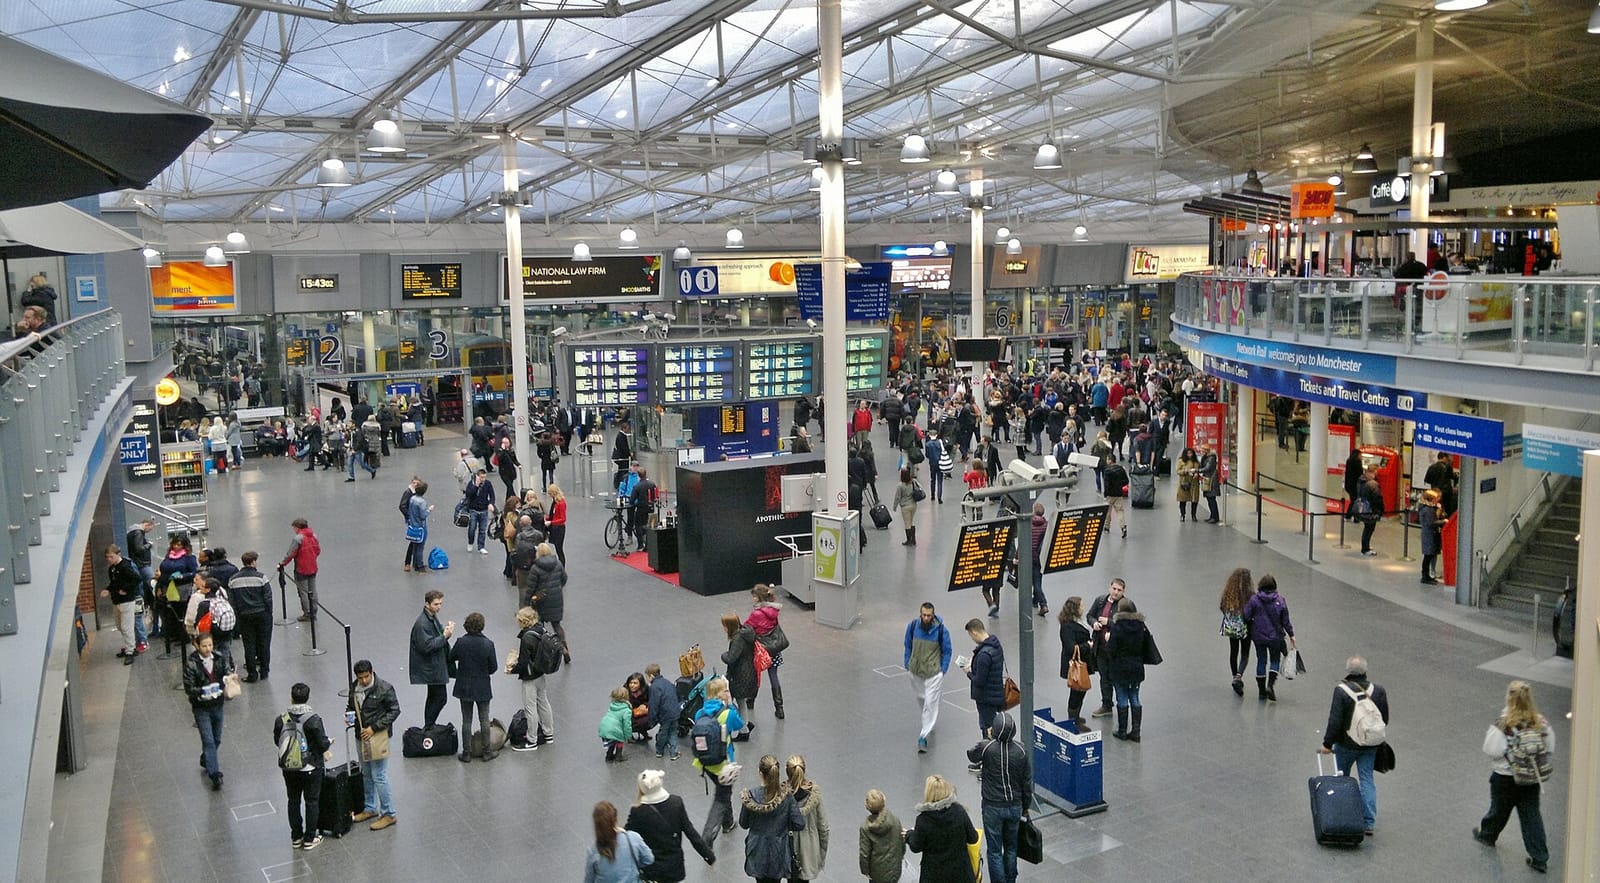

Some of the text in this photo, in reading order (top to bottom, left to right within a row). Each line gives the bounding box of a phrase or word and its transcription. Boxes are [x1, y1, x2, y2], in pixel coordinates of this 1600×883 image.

[1371, 181, 1391, 199] Caffè
[531, 267, 570, 276] NATIONAL
[570, 267, 587, 275] LAW
[588, 266, 606, 275] FIRM
[995, 306, 1010, 329] 6
[1059, 303, 1072, 327] 7
[319, 334, 342, 366] 2
[428, 329, 450, 360] 3
[1236, 342, 1362, 373] Network Rail welcomes you to Manchester
[1299, 378, 1390, 407] Tickets and Travel Centre
[1456, 428, 1473, 439] lounge
[120, 440, 142, 450] LIFT
[120, 450, 145, 459] ONLY
[755, 513, 785, 523] APOTHIC
